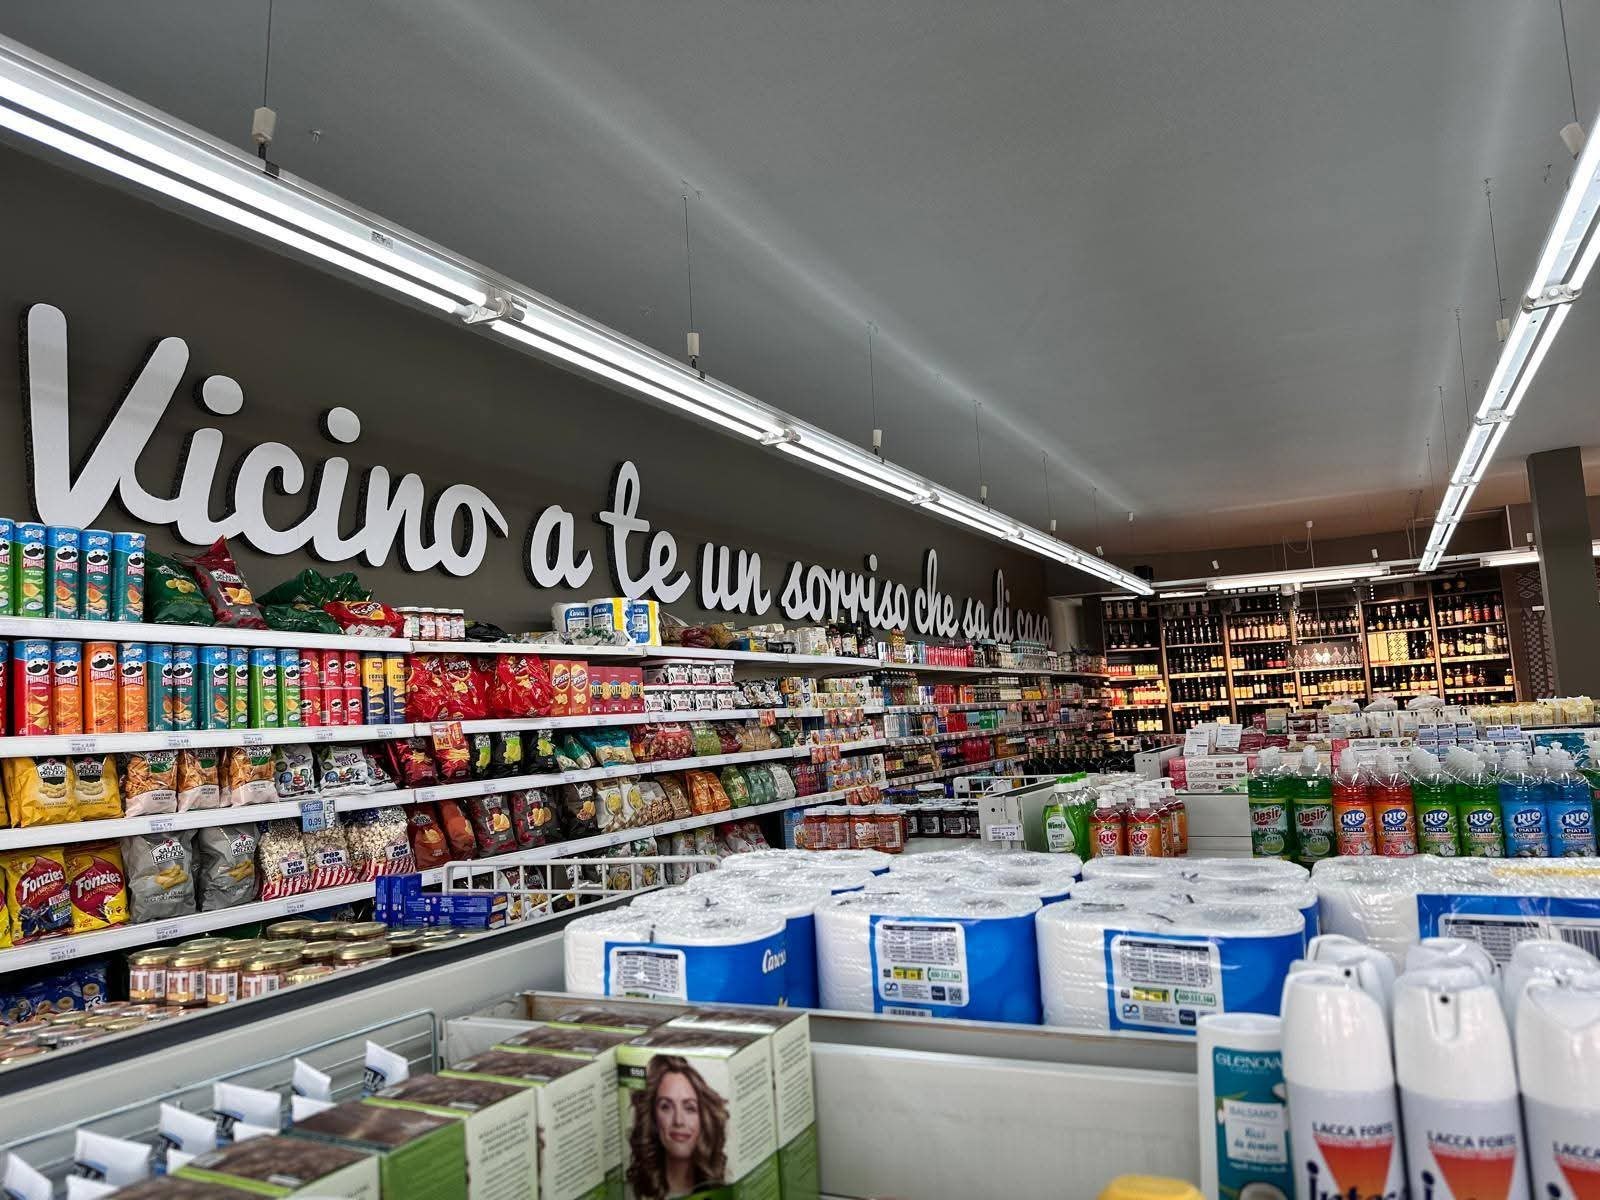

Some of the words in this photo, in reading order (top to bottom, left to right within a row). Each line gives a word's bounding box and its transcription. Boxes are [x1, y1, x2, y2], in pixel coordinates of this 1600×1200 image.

[24, 302, 509, 577] Vicino
[528, 504, 593, 589] a
[595, 461, 691, 604] te
[699, 542, 771, 616] un
[780, 553, 910, 631] sorriso
[913, 547, 959, 638] che
[962, 596, 990, 641] sa
[992, 568, 1014, 644] di
[1015, 608, 1055, 648] casa
[56, 561, 79, 572] PRINGLES
[87, 564, 109, 575] PRINGLES
[26, 675, 50, 686] PRINGLES
[54, 676, 79, 687] PRINGLES
[90, 669, 116, 682] PRINGLES
[121, 676, 144, 687] PRINGLES
[308, 817, 322, 827] 0,99
[1344, 811, 1366, 824] RIO
[1384, 810, 1407, 824] RIO
[1424, 812, 1449, 825] RIO
[1469, 812, 1494, 825] RIO
[1516, 811, 1542, 825] RIO
[1564, 811, 1590, 825] RIO
[1099, 833, 1117, 844] RIO
[1131, 833, 1148, 844] RIO
[155, 850, 184, 861] PREZIOSI
[159, 846, 182, 856] SALATI
[323, 851, 339, 860] POP
[321, 857, 342, 866] CORN
[22, 869, 64, 902] Fonzies
[76, 869, 121, 899] Fonzies
[1216, 1052, 1283, 1068] GLENOVA
[1229, 1105, 1279, 1119] BALSAMO
[1312, 1121, 1355, 1138] LACCA
[1359, 1121, 1394, 1137] FORTE
[1427, 1130, 1475, 1149] LACCA
[1477, 1133, 1517, 1149] FORTE
